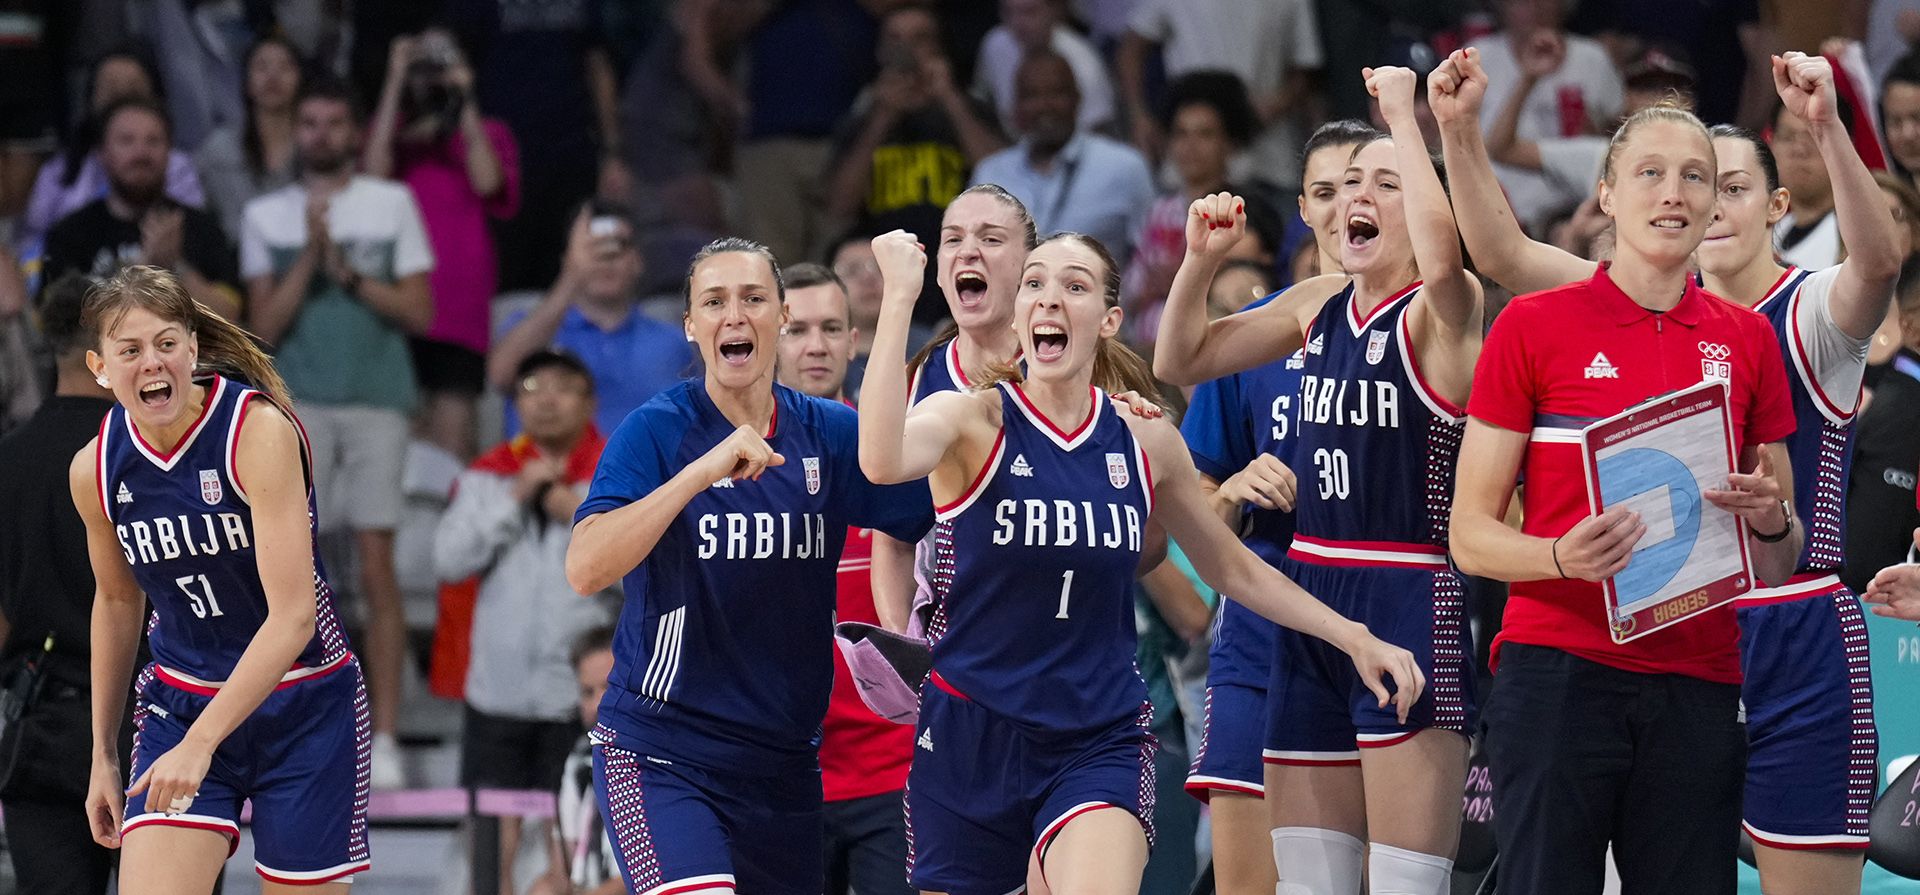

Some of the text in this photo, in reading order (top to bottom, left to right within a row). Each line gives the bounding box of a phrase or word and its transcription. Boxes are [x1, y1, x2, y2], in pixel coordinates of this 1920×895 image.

[1584, 366, 1620, 379] PEAK
[1603, 428, 1632, 444] WOMEN'S
[1631, 417, 1659, 433] NATIONAL
[1659, 406, 1695, 423] BASKETBALL
[1010, 464, 1034, 477] PEAK
[1313, 447, 1351, 500] 30
[116, 513, 250, 566] SRBIJA
[698, 512, 825, 560] SRBIJA
[992, 499, 1141, 553] SRBIJA
[175, 574, 224, 619] 51
[1055, 570, 1074, 619] 1
[1652, 590, 1708, 625] SERBIA
